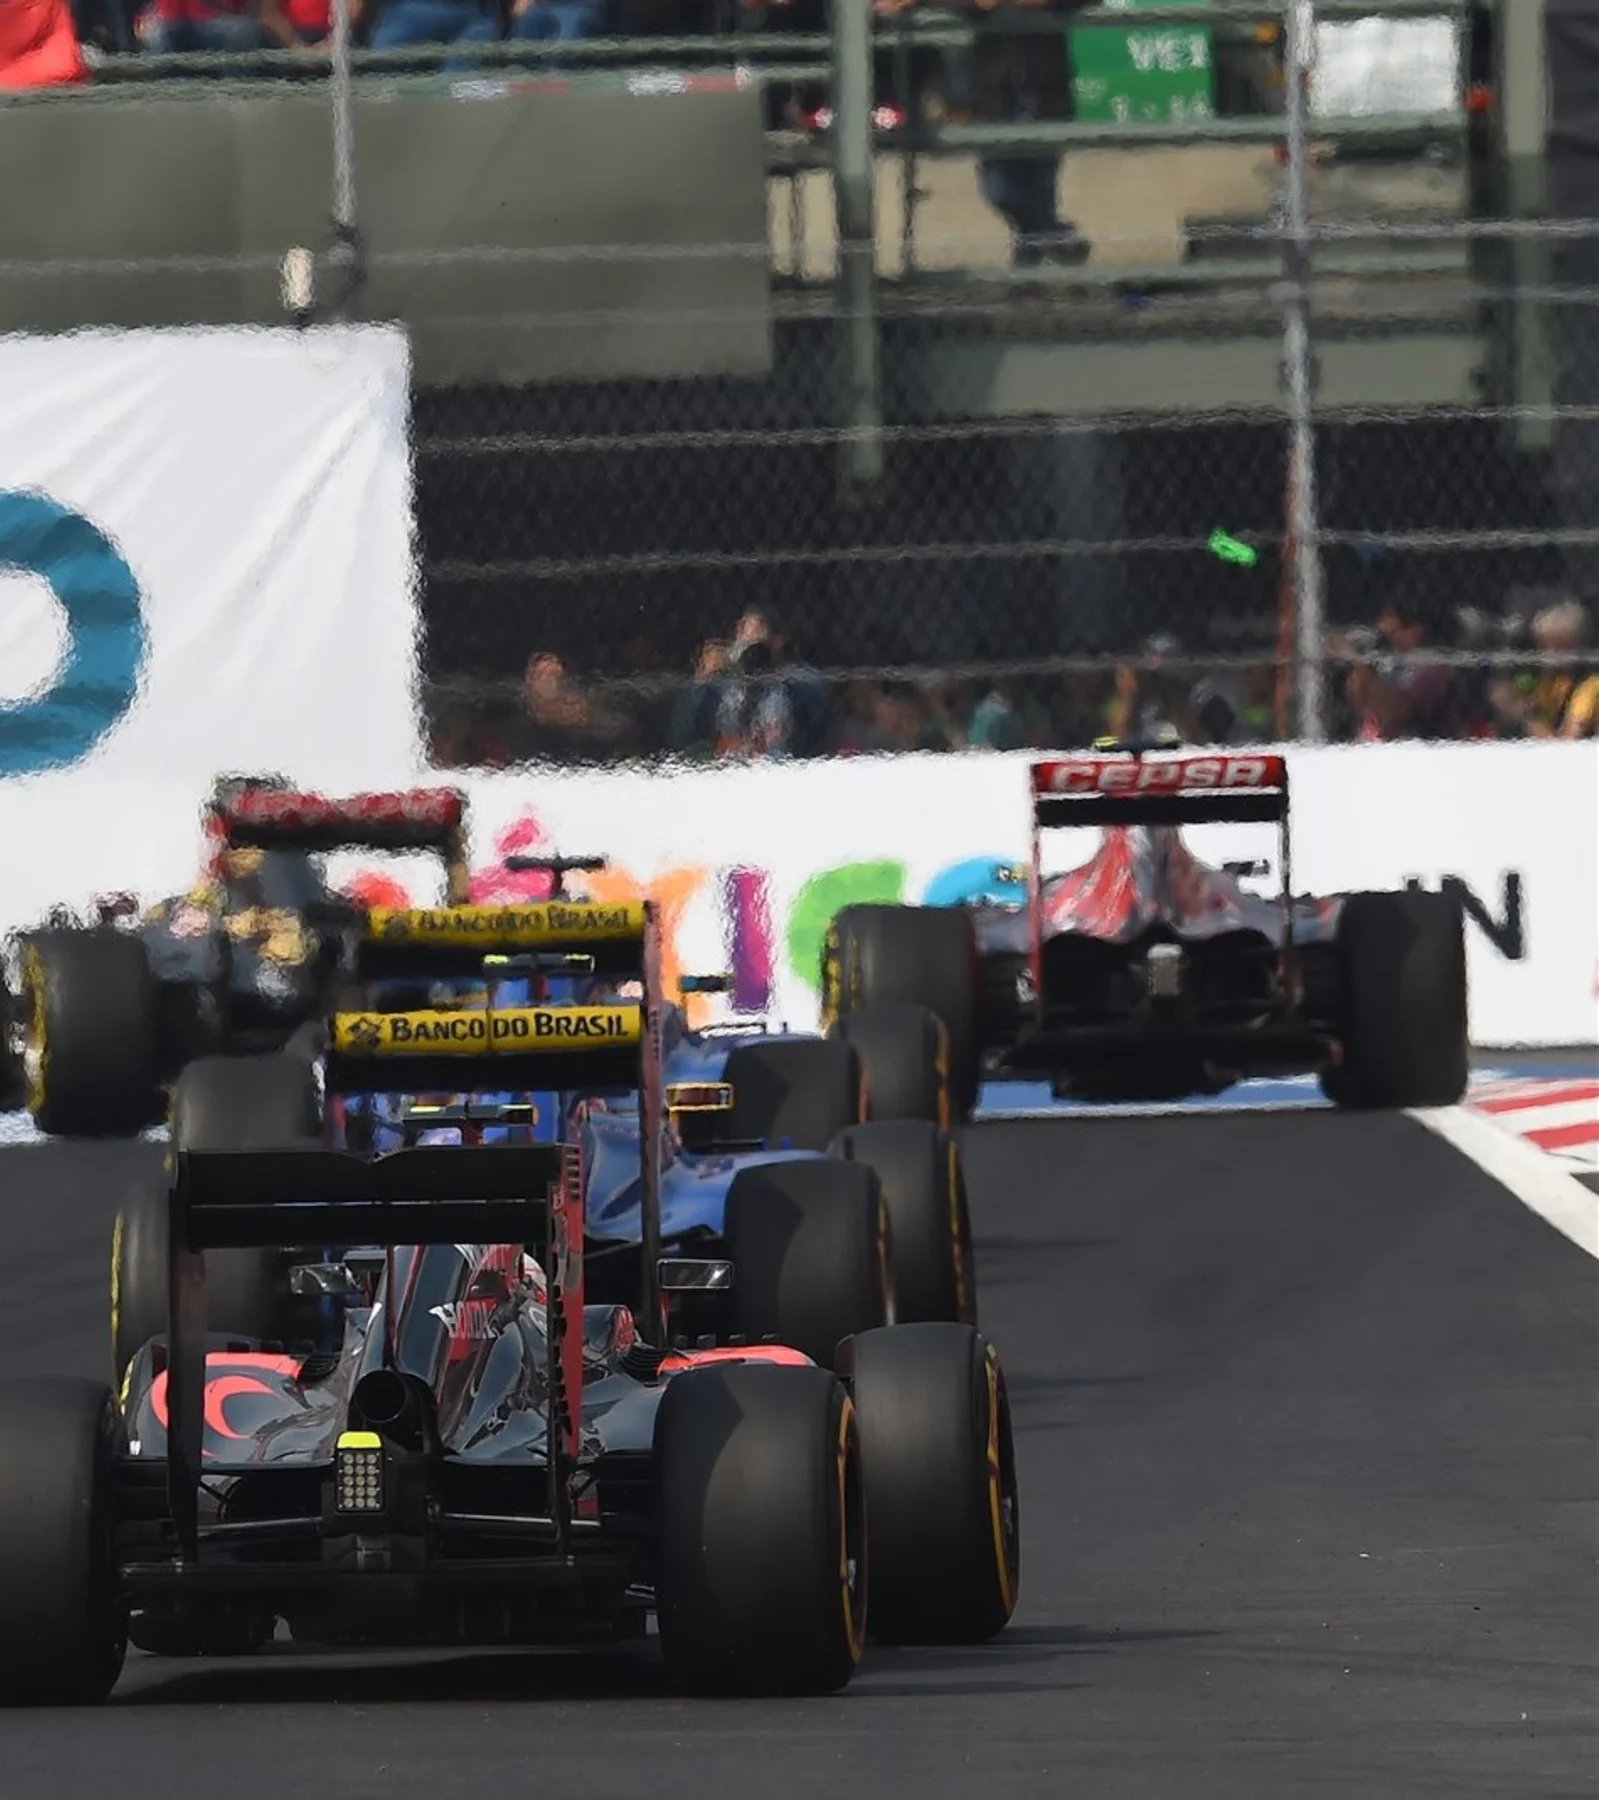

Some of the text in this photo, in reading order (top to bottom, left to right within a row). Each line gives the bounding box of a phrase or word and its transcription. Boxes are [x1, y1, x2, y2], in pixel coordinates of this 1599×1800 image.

[1053, 759, 1266, 791] CEPSA
[418, 908, 500, 933] BANCO
[547, 903, 629, 931] BRASIL
[1405, 870, 1524, 961] N
[389, 1017, 486, 1043] BANCO
[491, 1014, 530, 1040] DO
[534, 1011, 628, 1038] BRASIL
